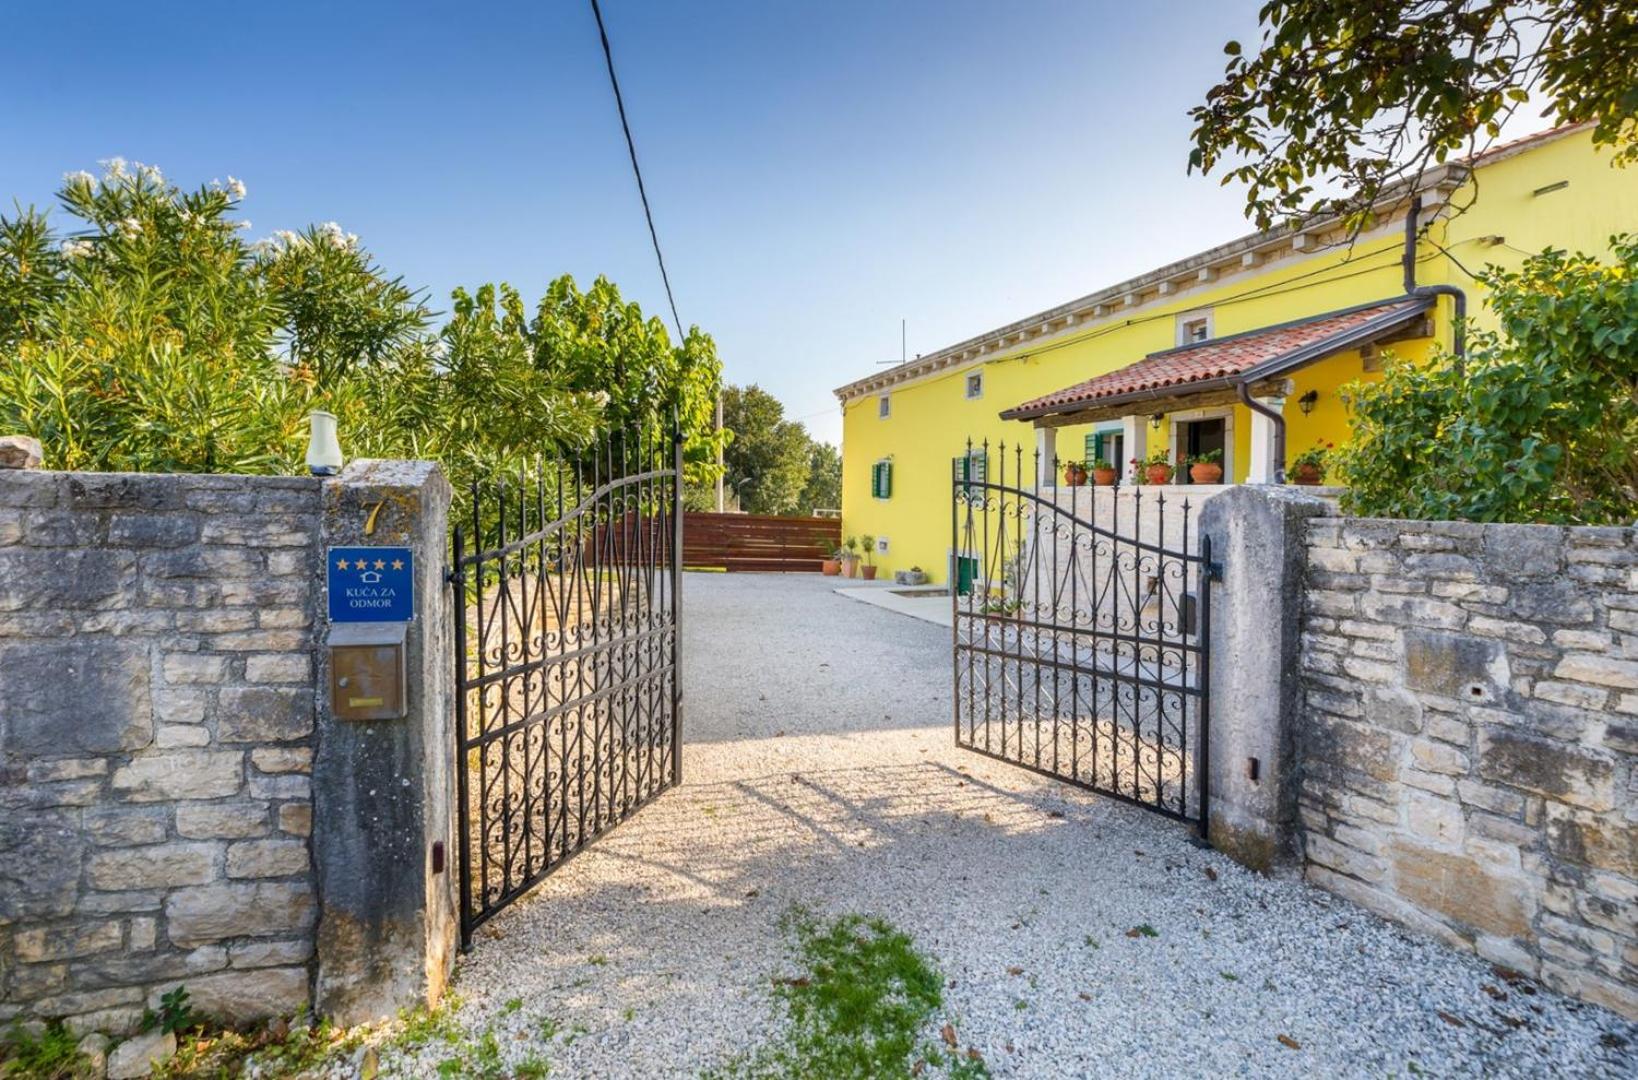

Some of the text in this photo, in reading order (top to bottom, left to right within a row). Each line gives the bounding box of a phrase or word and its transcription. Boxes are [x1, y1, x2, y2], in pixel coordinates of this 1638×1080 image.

[360, 500, 384, 535] 7
[381, 588, 396, 597] ZA
[350, 599, 392, 608] ODMOR
